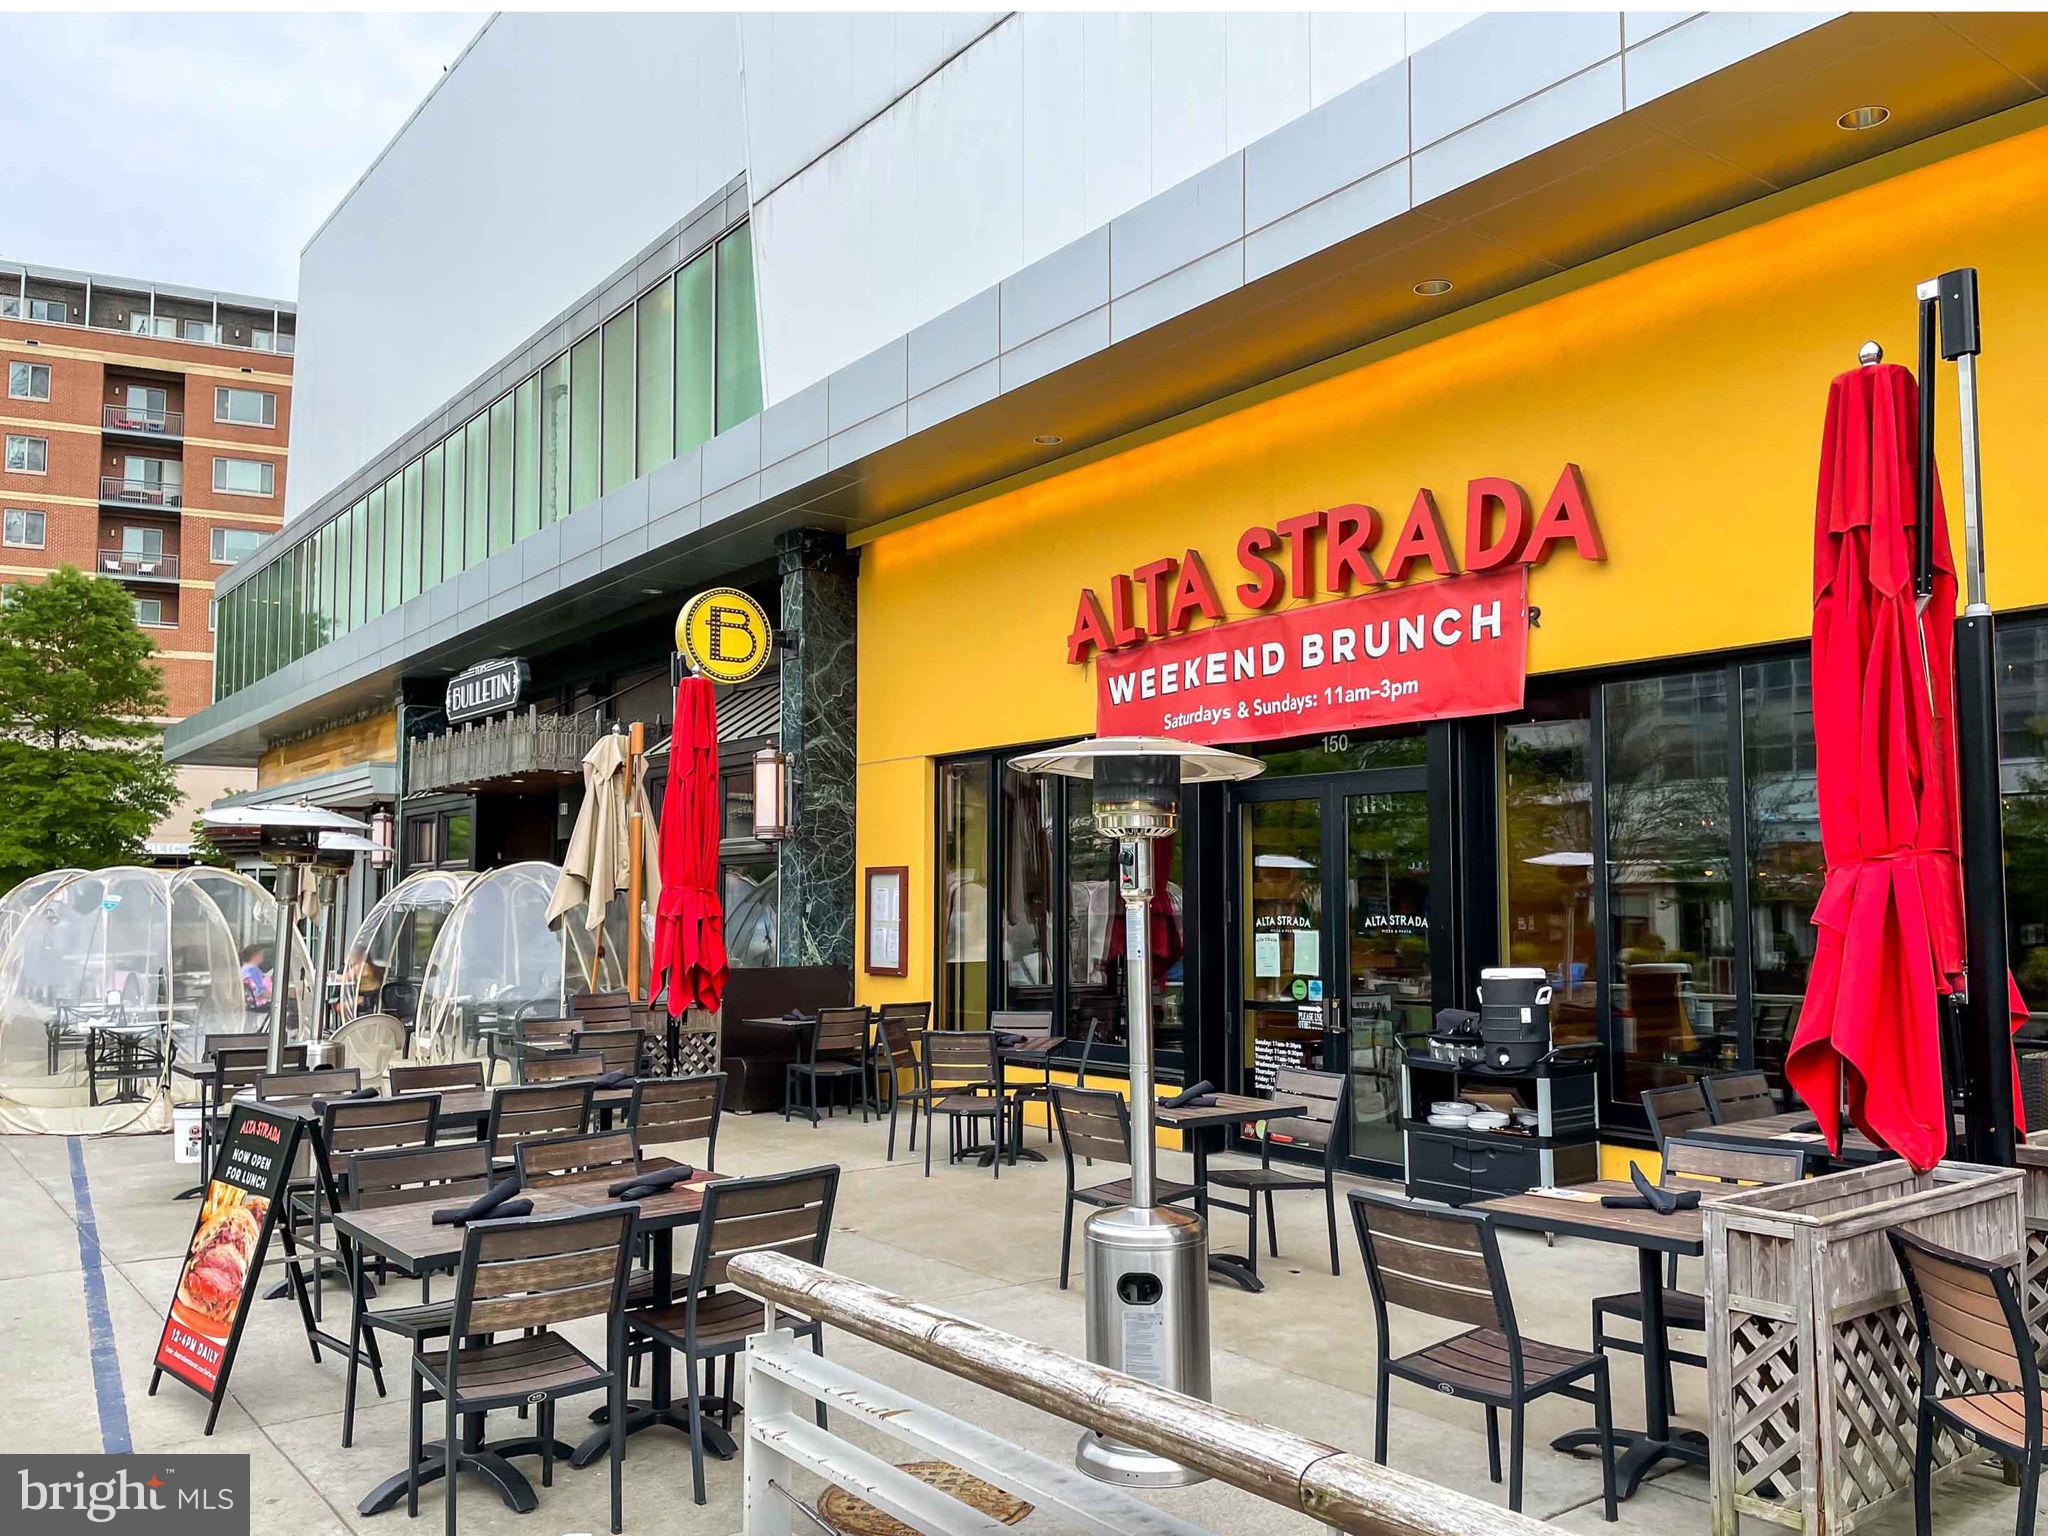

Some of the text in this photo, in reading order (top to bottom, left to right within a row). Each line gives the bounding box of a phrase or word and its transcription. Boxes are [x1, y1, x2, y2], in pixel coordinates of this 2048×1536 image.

[1067, 462, 1608, 665] ALTA STRADA
[1108, 600, 1501, 706] WEEKEND BRUNCH
[452, 671, 511, 711] BULLETIN
[1163, 705, 1232, 730] Saturdays
[1237, 701, 1249, 719] &
[1254, 692, 1318, 715] Sundays:
[1321, 734, 1348, 753] 150
[1256, 915, 1311, 929] ALTA STRADA
[1364, 914, 1429, 929] ALTA STRADA
[240, 1119, 281, 1144] ALTA STRADA
[232, 1148, 272, 1171] NOW OPEN
[225, 1165, 268, 1190] FOR LUNCH
[197, 1342, 219, 1364] DAILY
